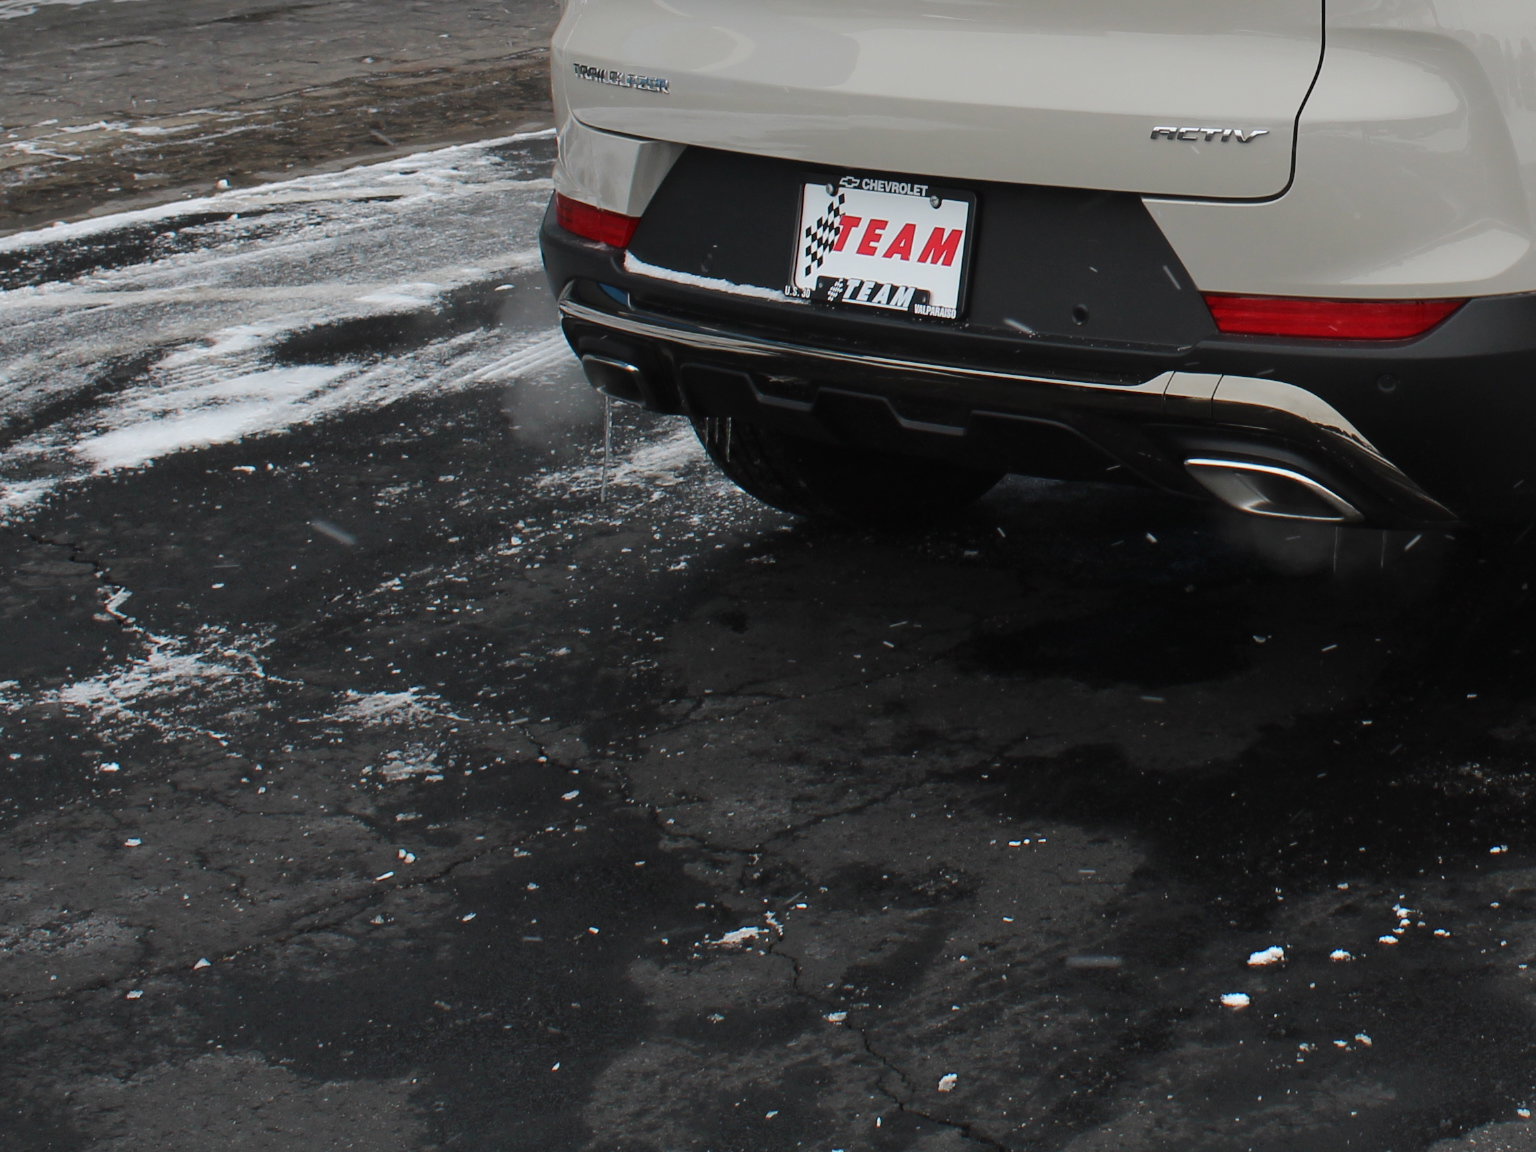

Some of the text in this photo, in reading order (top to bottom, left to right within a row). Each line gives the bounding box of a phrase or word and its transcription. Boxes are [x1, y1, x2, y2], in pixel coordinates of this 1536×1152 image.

[1150, 126, 1270, 144] ACTIV
[862, 178, 929, 197] CHEVROLET
[833, 214, 963, 267] TEAM
[784, 285, 811, 299] U.S. 30
[842, 278, 916, 309] TEAM
[914, 303, 957, 320] VALPARAISO
